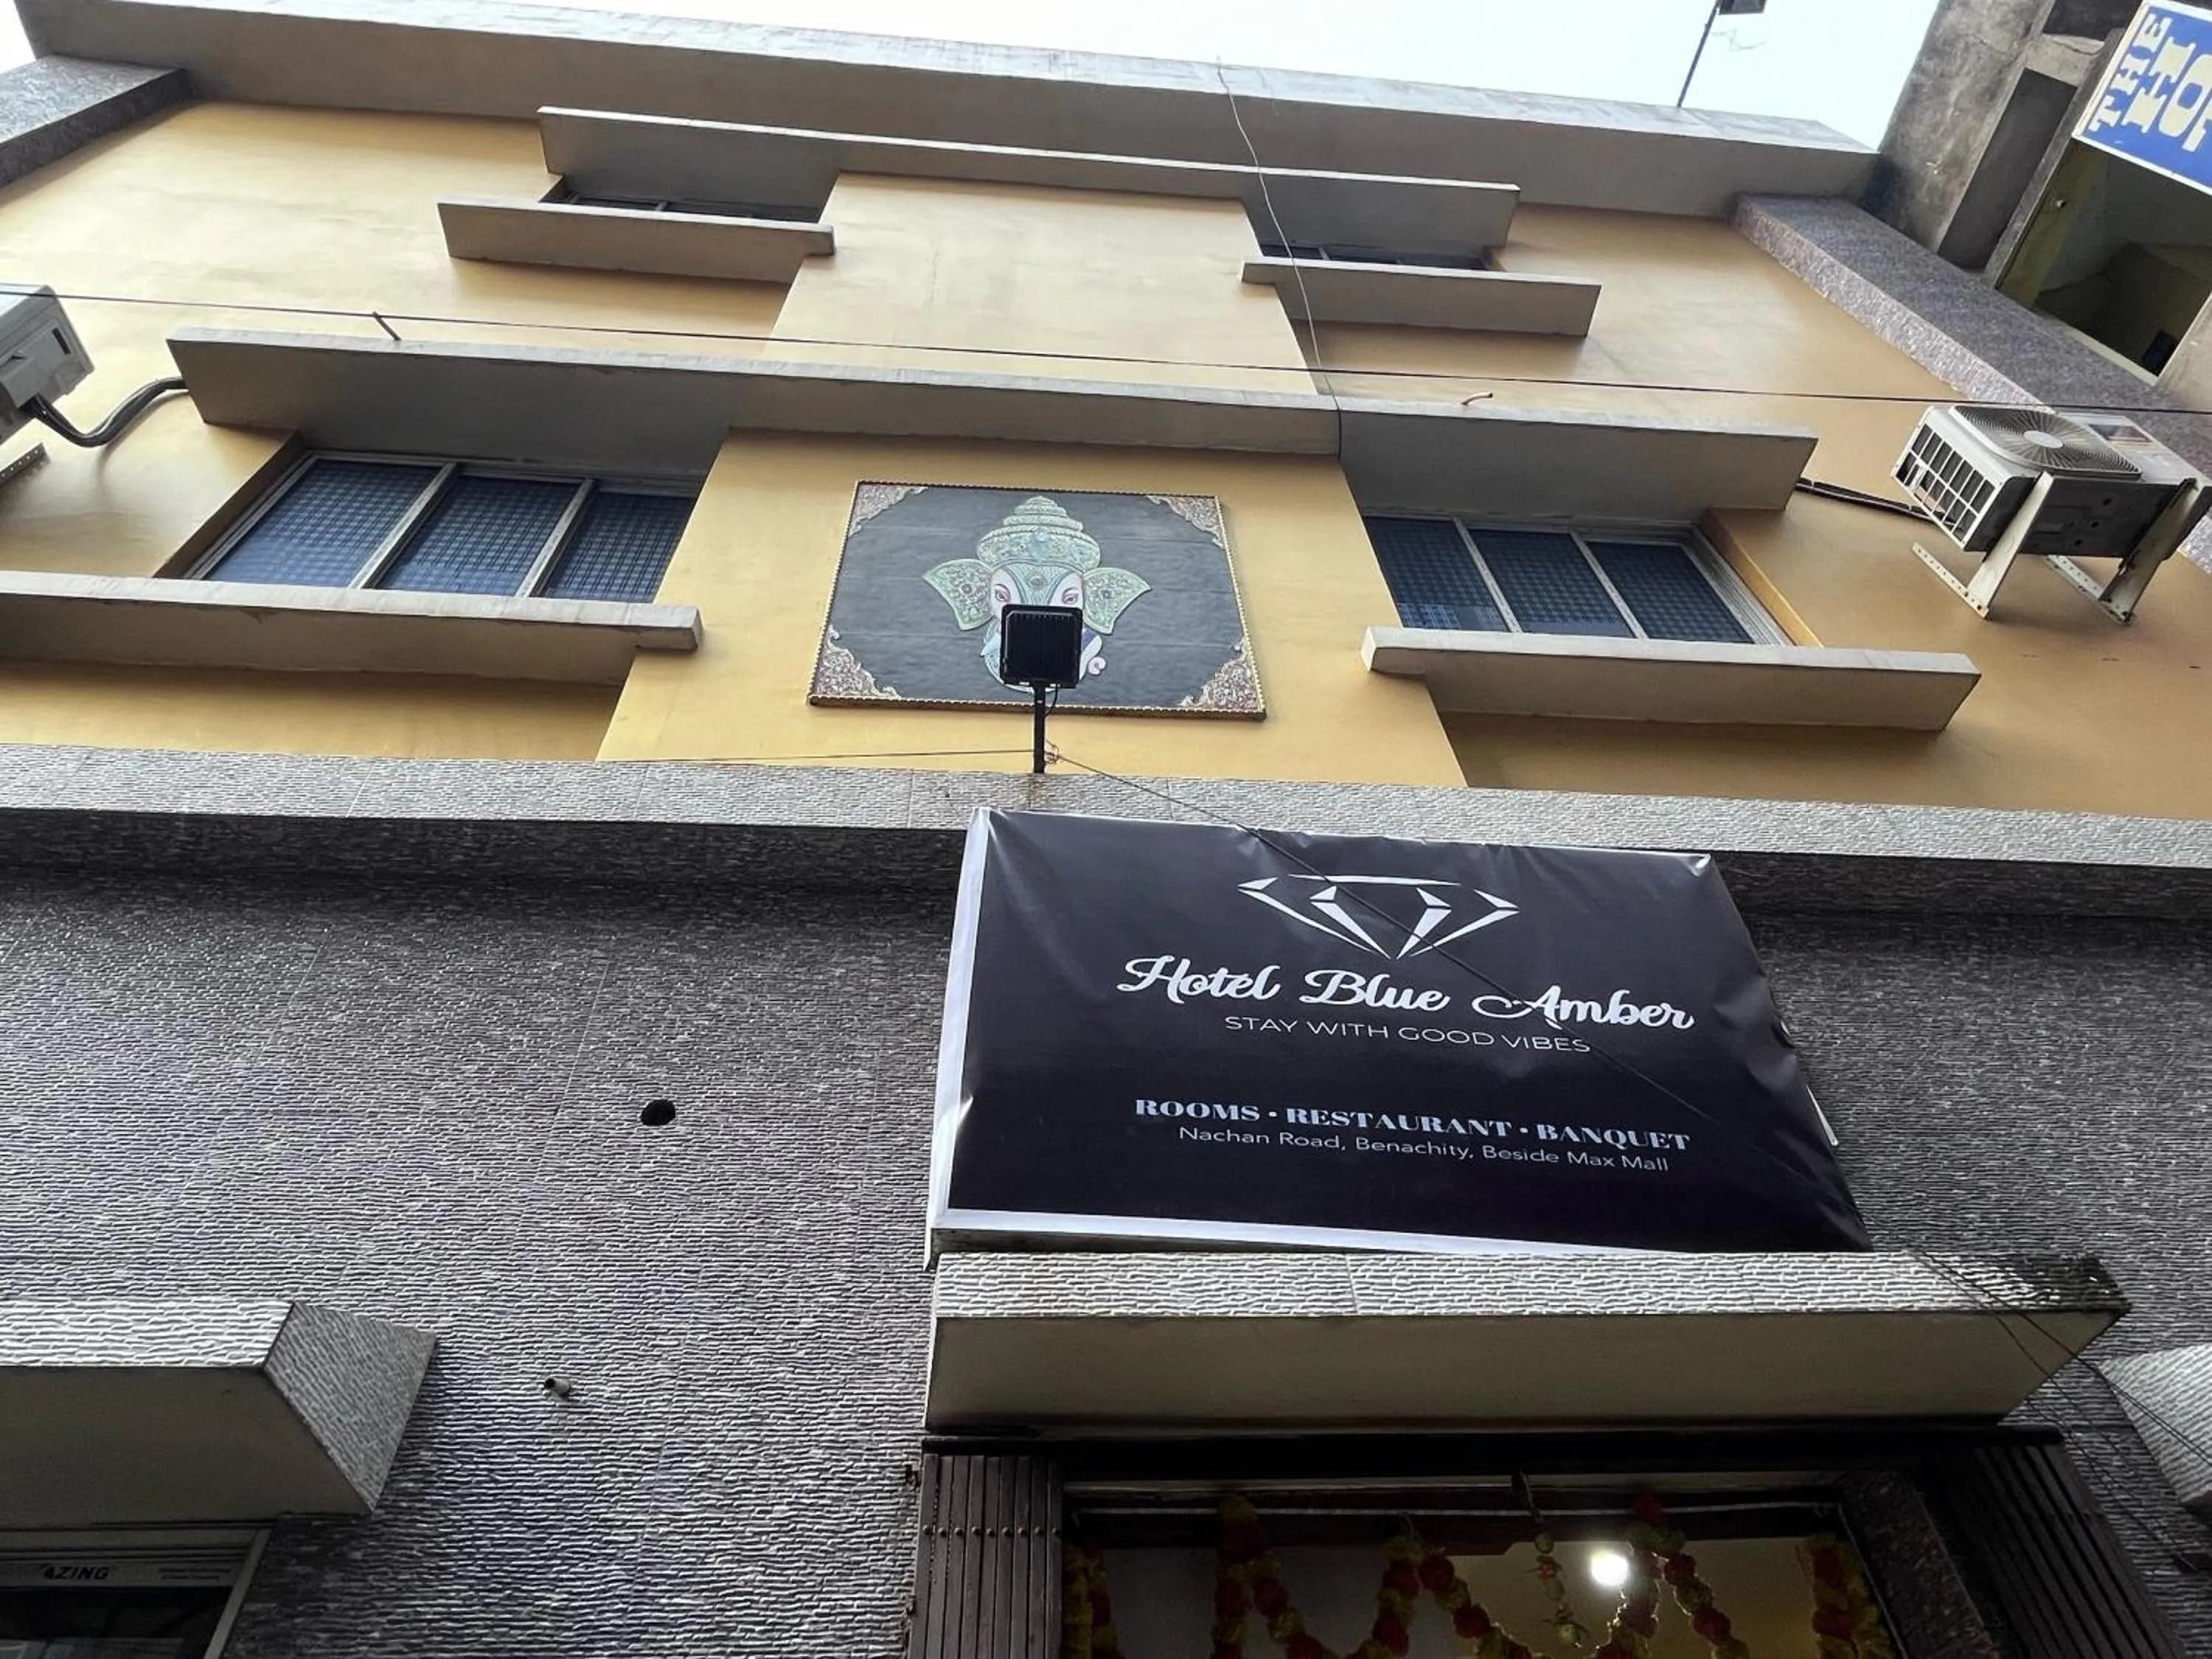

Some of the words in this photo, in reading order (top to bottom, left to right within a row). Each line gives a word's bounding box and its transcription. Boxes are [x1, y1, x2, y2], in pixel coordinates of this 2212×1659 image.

[2088, 13, 2174, 132] THE
[1116, 955, 1281, 1004] Hotel
[1299, 970, 1451, 1011] Blue
[1472, 984, 1695, 1029] Amber
[1225, 1016, 1298, 1033] STAY
[1306, 1020, 1388, 1039] WITH
[1398, 1026, 1495, 1046] GOOD
[1501, 1034, 1591, 1053] VIBES
[1135, 1099, 1260, 1121] ROOMS
[1287, 1108, 1513, 1137] RESTAURANT
[1537, 1124, 1691, 1151] BANQUET
[1179, 1126, 1270, 1144] Nachan
[1279, 1132, 1346, 1151] Road,
[1356, 1137, 1474, 1160] Benachity,
[1483, 1144, 1559, 1164] Beside
[1568, 1151, 1615, 1168] Max
[1622, 1155, 1669, 1172] Mall
